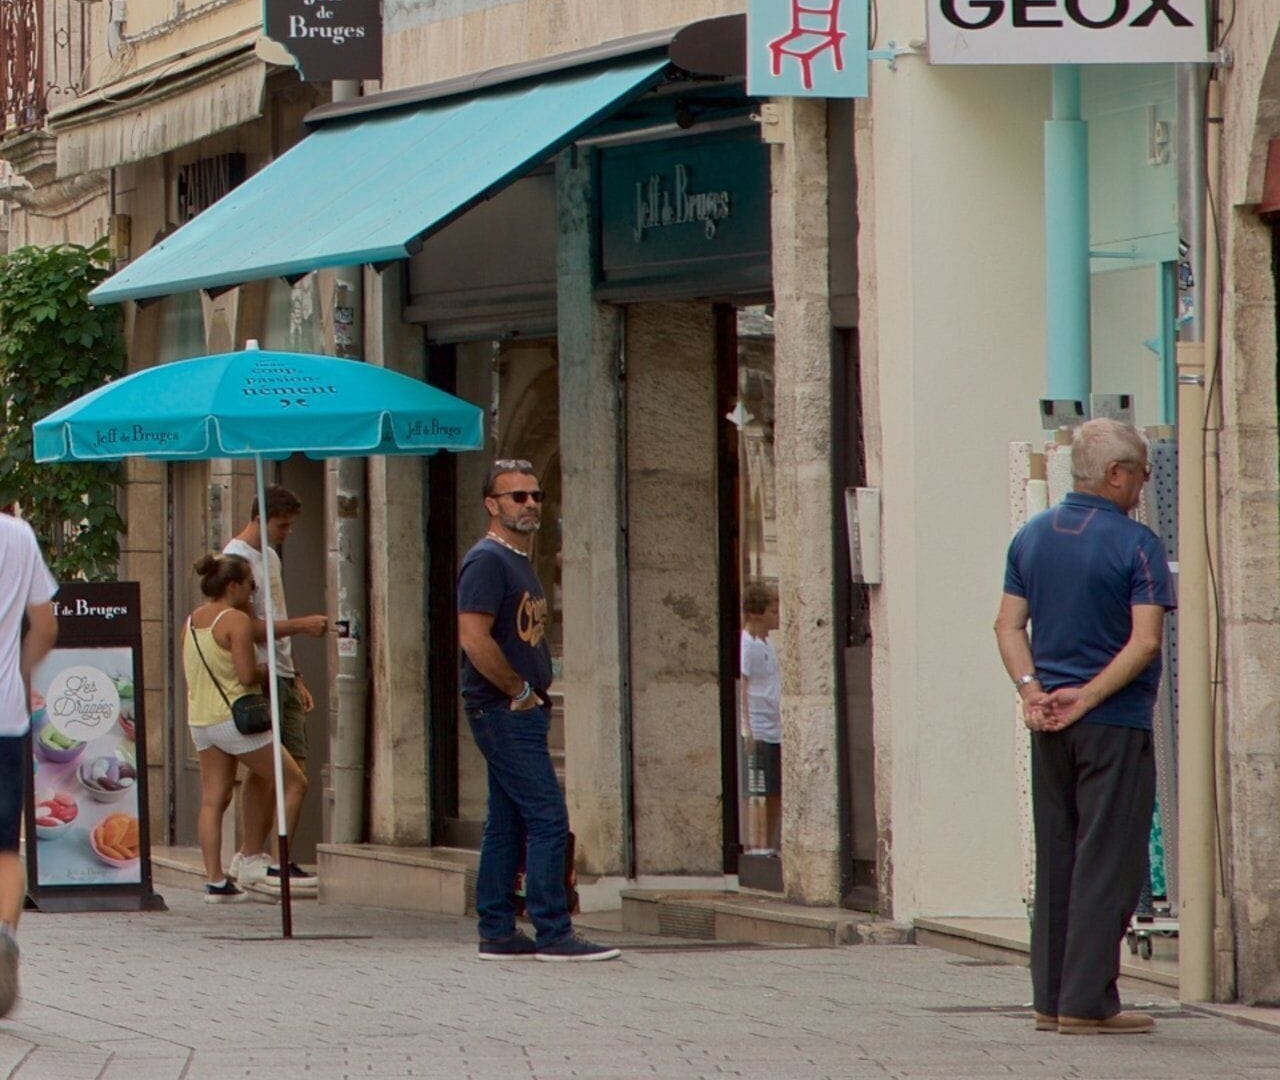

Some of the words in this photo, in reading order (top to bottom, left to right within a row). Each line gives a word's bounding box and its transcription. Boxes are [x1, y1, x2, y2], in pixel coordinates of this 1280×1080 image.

[316, 5, 334, 19] de
[289, 15, 365, 45] Bruges
[633, 174, 660, 243] Jeff
[674, 163, 729, 241] Bruges
[242, 385, 338, 397] nément
[93, 427, 117, 449] Jeff
[132, 423, 179, 446] Bruges
[431, 417, 462, 438] Bruges
[61, 603, 74, 616] de
[75, 599, 128, 620] Bruges
[64, 675, 98, 702] Les
[53, 696, 114, 721] Dragées
